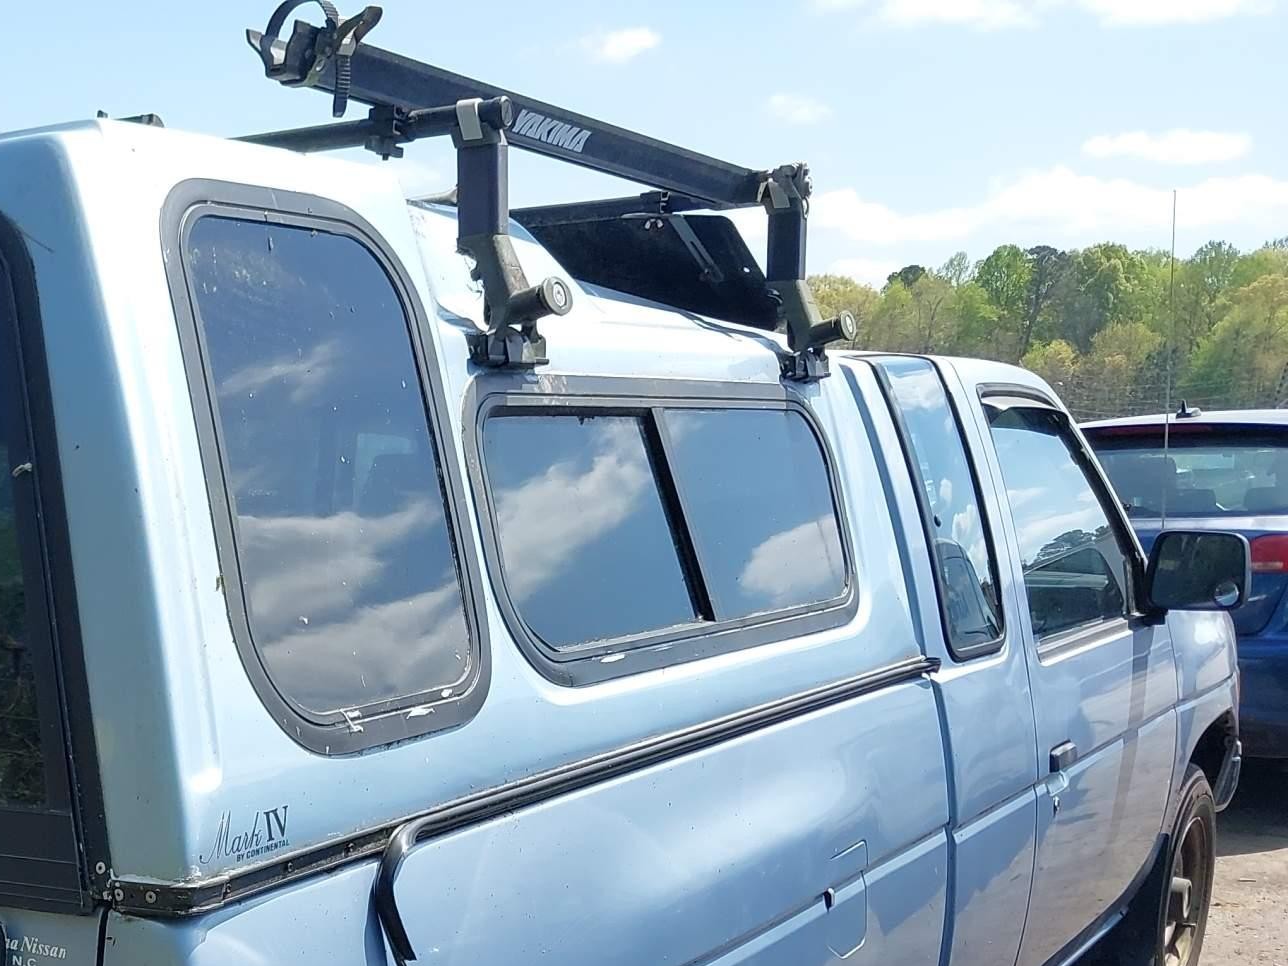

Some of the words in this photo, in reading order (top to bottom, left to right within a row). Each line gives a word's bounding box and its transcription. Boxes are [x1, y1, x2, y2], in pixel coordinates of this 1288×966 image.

[512, 108, 592, 153] YAKIMA
[199, 810, 262, 864] Mark
[263, 805, 289, 842] IV
[236, 852, 245, 862] BY
[246, 839, 290, 859] CONTINENTAL
[20, 935, 67, 960] Nissan
